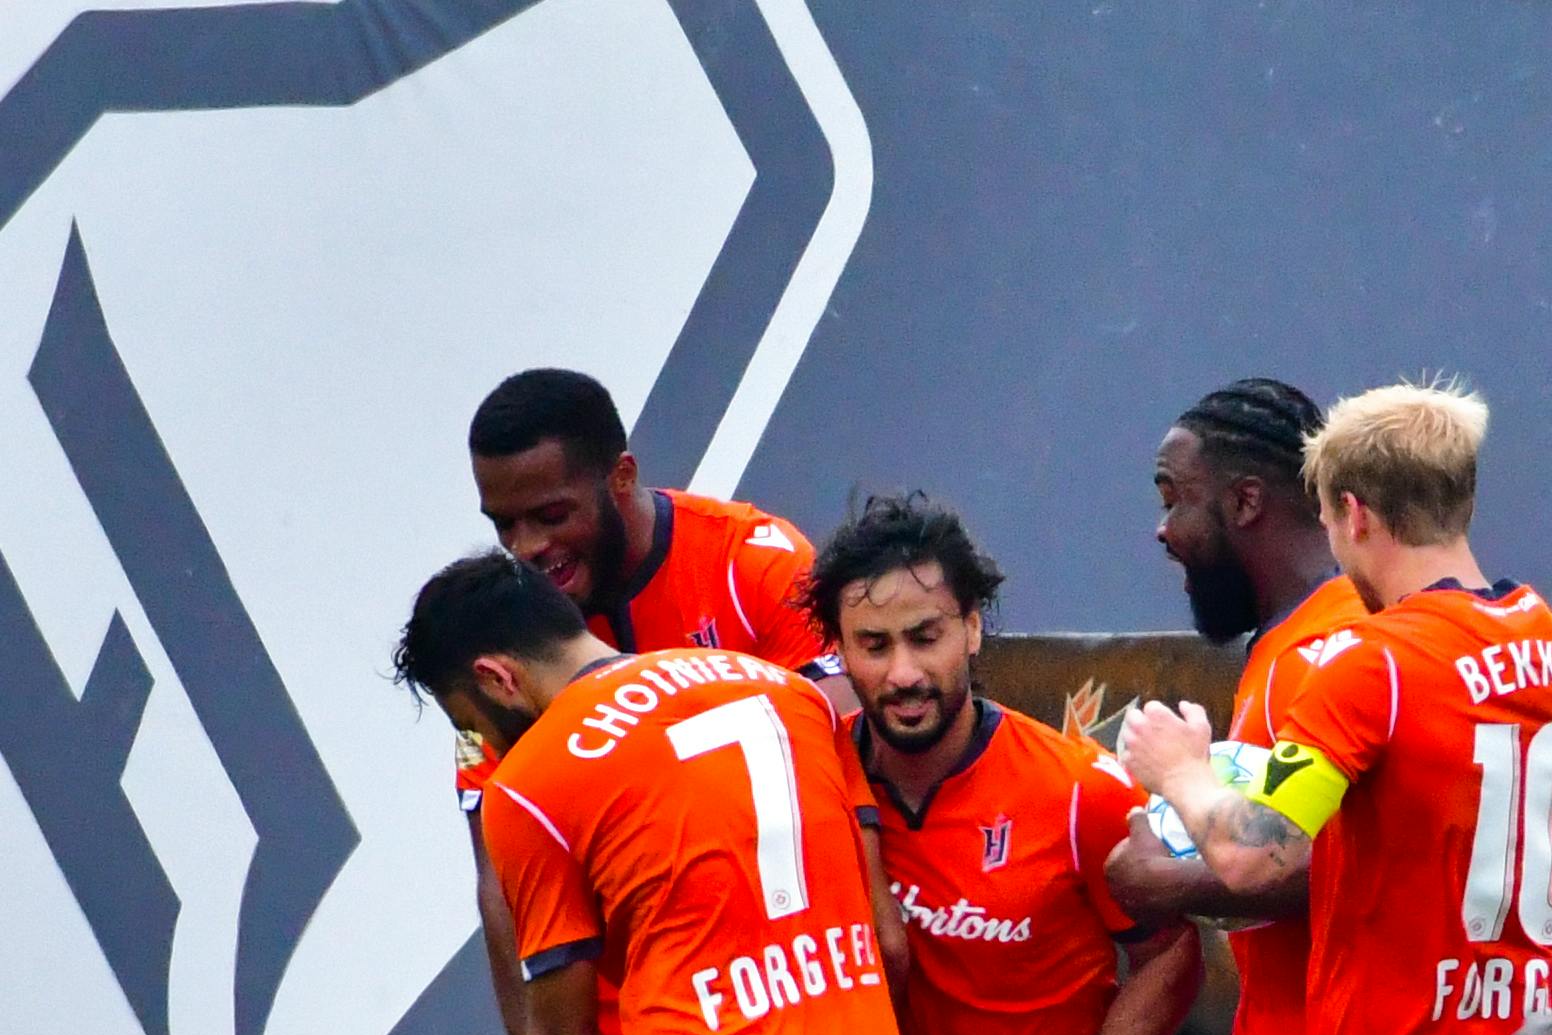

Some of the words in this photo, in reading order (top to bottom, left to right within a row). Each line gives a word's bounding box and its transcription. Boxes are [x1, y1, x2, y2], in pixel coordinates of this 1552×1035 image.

[665, 693, 809, 921] 7
[692, 927, 853, 1031] FORGE
[1432, 958, 1549, 1021] FORG
